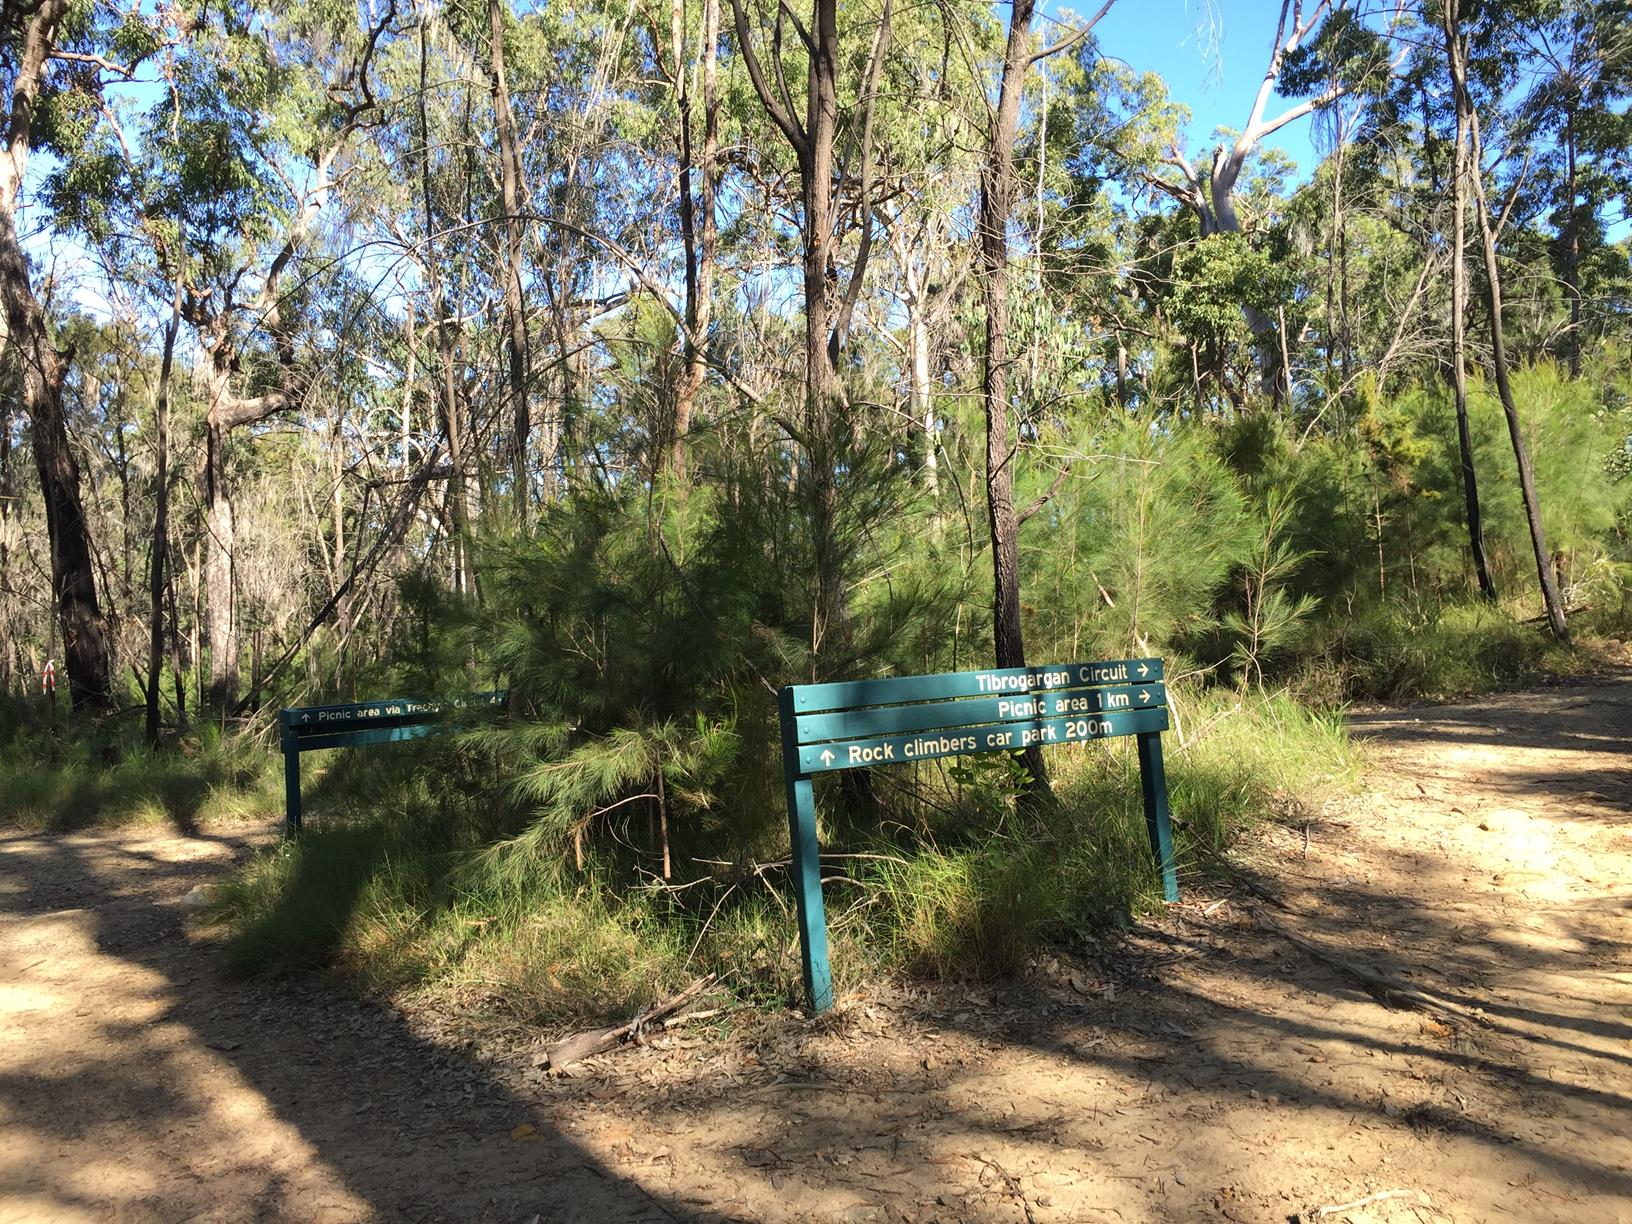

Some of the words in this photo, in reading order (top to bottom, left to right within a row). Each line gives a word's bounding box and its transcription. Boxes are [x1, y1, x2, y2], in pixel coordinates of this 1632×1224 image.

[976, 670, 1070, 692] Tibrogargan
[1079, 664, 1128, 682] Circuit
[318, 709, 352, 721] Picnic
[356, 707, 381, 718] area
[385, 705, 401, 715] via
[998, 699, 1047, 718] Picnic
[1055, 697, 1089, 713] area
[848, 742, 895, 764] Rock
[903, 736, 977, 757] climbers
[986, 731, 1013, 747] car
[1021, 725, 1057, 747] park
[1065, 719, 1113, 739] 200m
